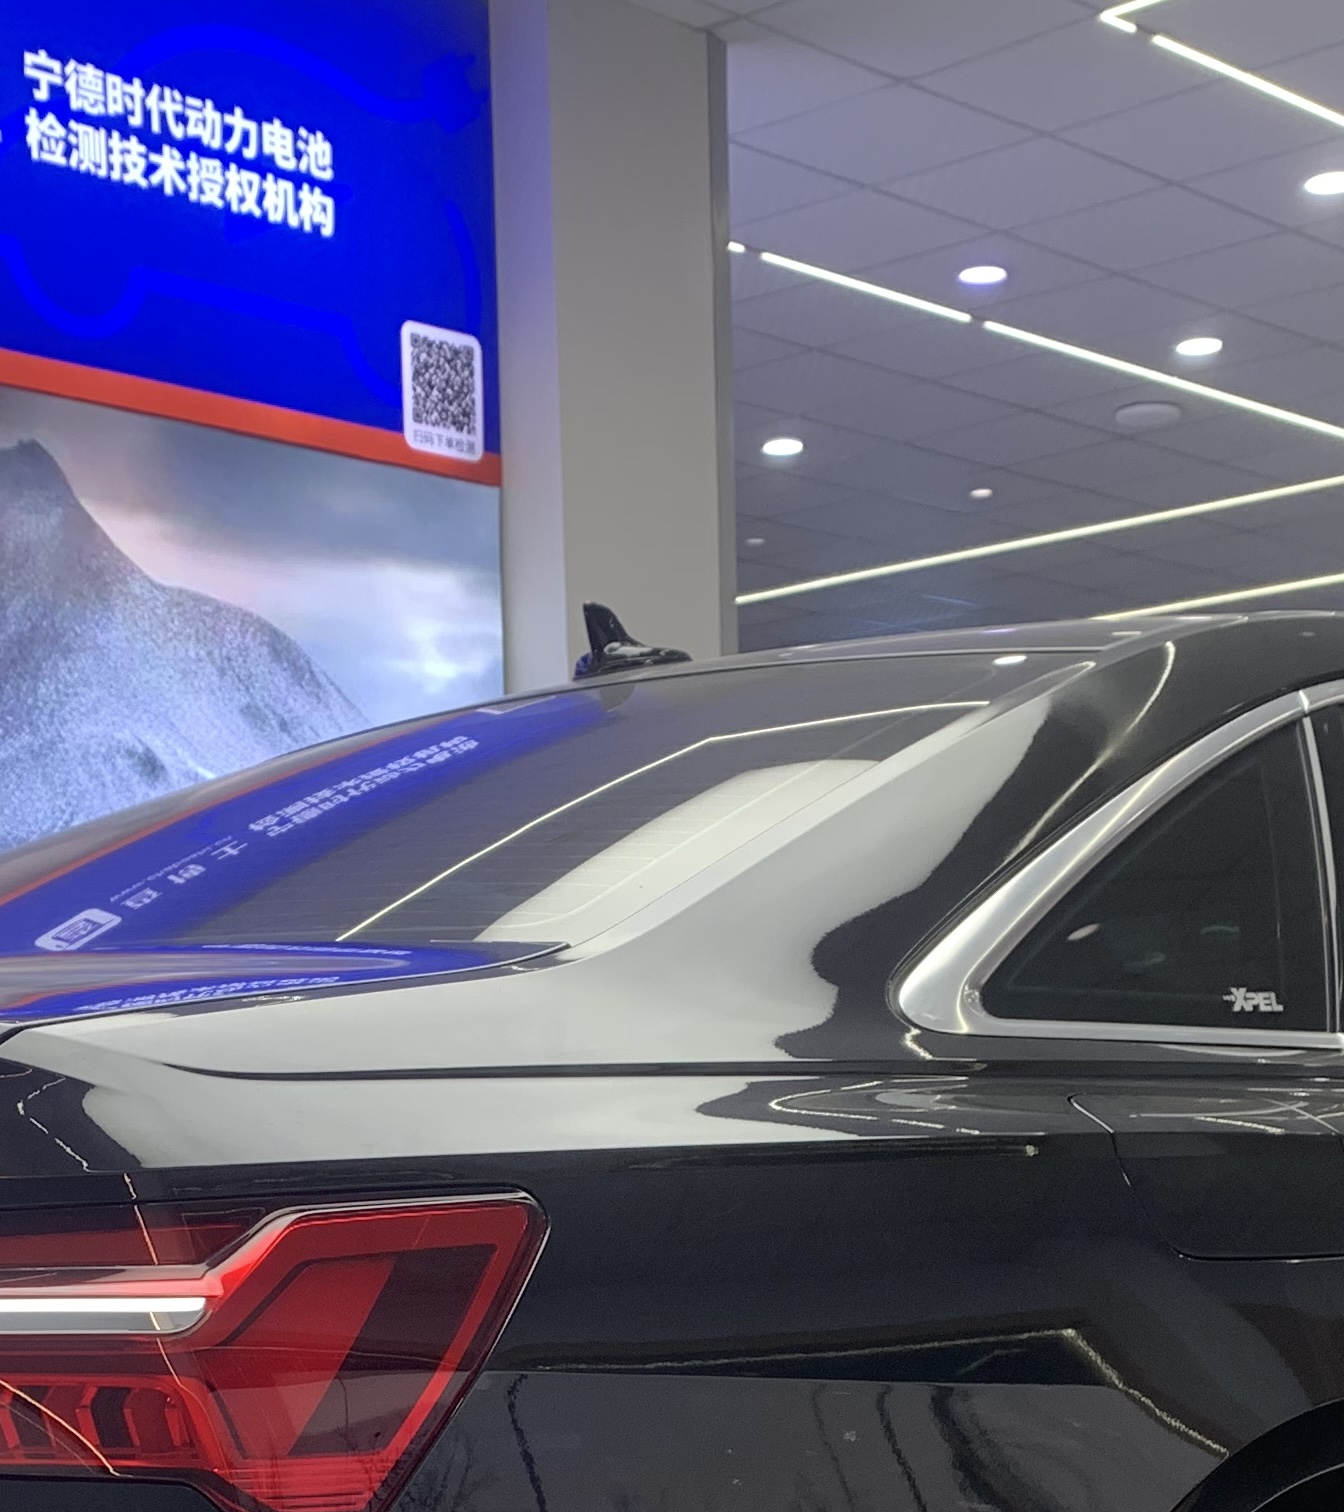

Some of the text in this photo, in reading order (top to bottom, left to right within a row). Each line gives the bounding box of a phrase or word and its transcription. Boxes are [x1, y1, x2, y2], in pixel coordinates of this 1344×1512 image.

[23, 49, 334, 181] 宁德时代动力电池
[24, 107, 335, 238] 检测技术授权机构
[1229, 987, 1284, 1012] XPEL
